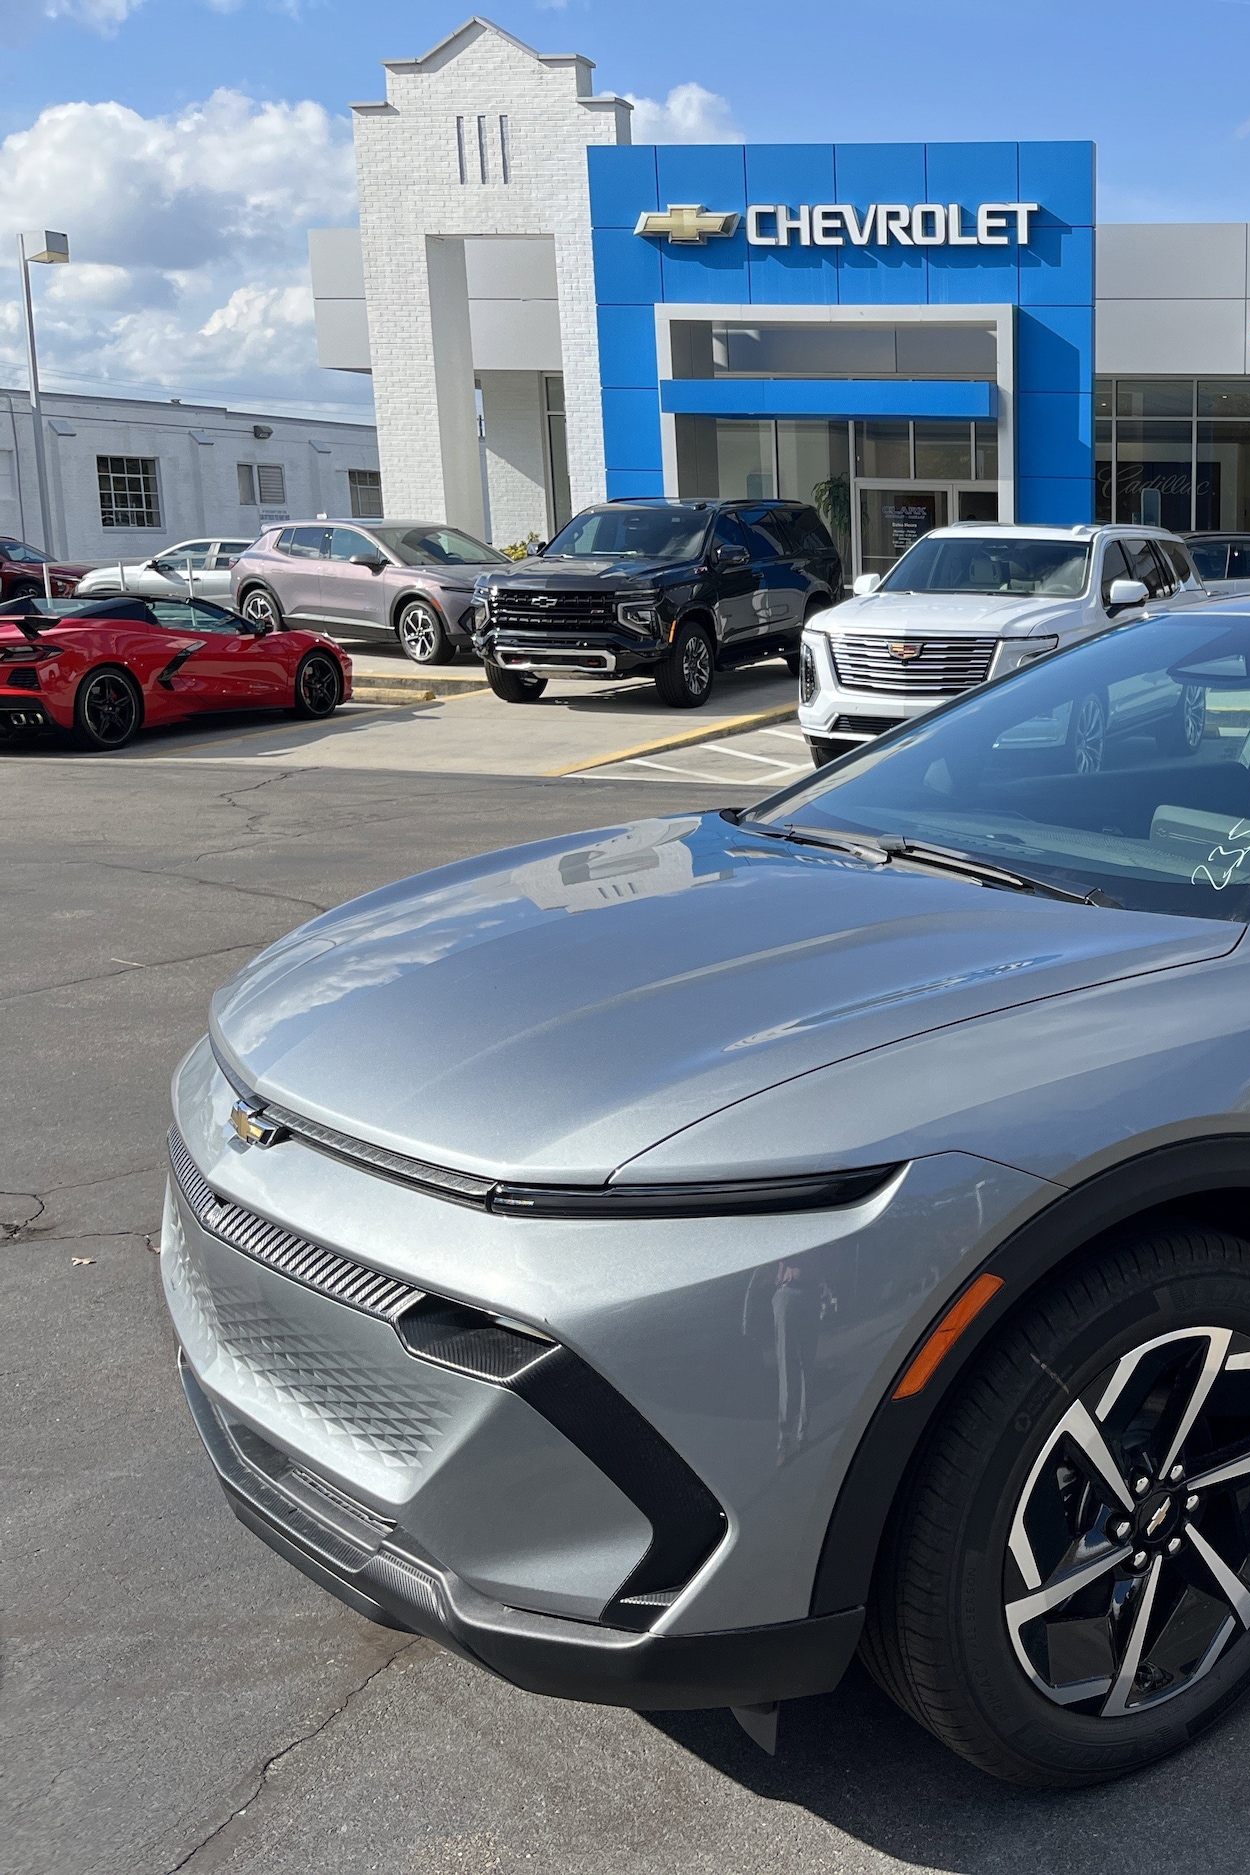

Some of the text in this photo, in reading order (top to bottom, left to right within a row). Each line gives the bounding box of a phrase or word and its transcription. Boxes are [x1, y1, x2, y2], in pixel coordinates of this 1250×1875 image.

[746, 203, 1038, 246] CHEVROLET
[882, 506, 927, 515] CLARK
[965, 1567, 977, 1622] SEASON
